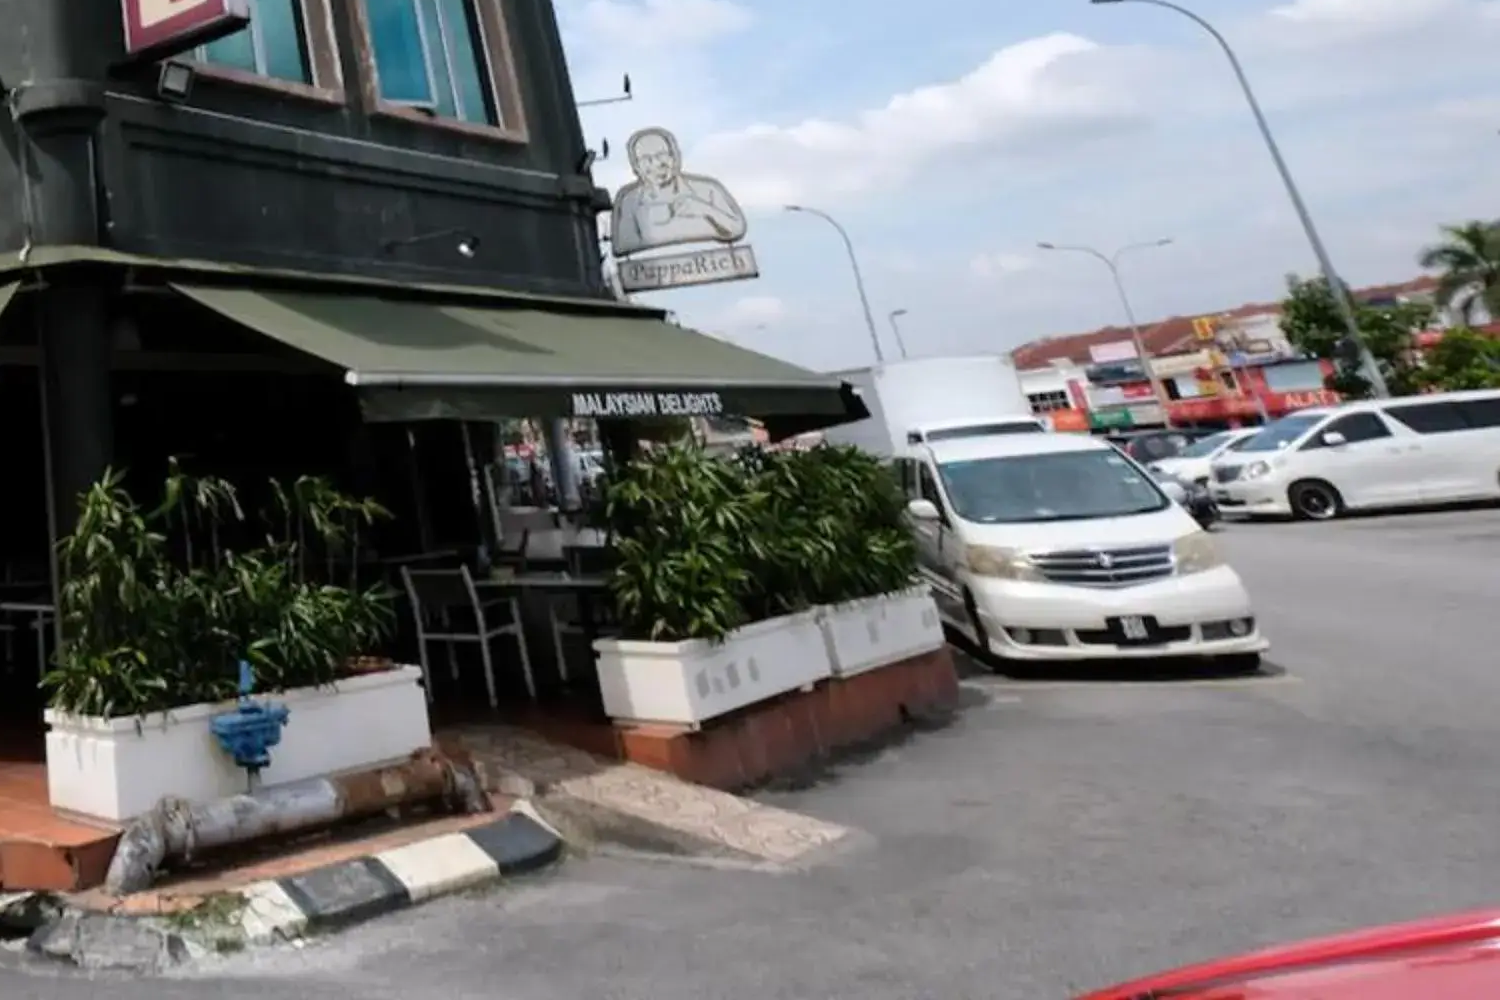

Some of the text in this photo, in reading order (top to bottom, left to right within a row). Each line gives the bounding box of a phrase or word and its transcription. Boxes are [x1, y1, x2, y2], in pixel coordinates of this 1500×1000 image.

[629, 251, 745, 284] PappaRich
[572, 391, 724, 416] MALAYSIAN DELIGHTS
